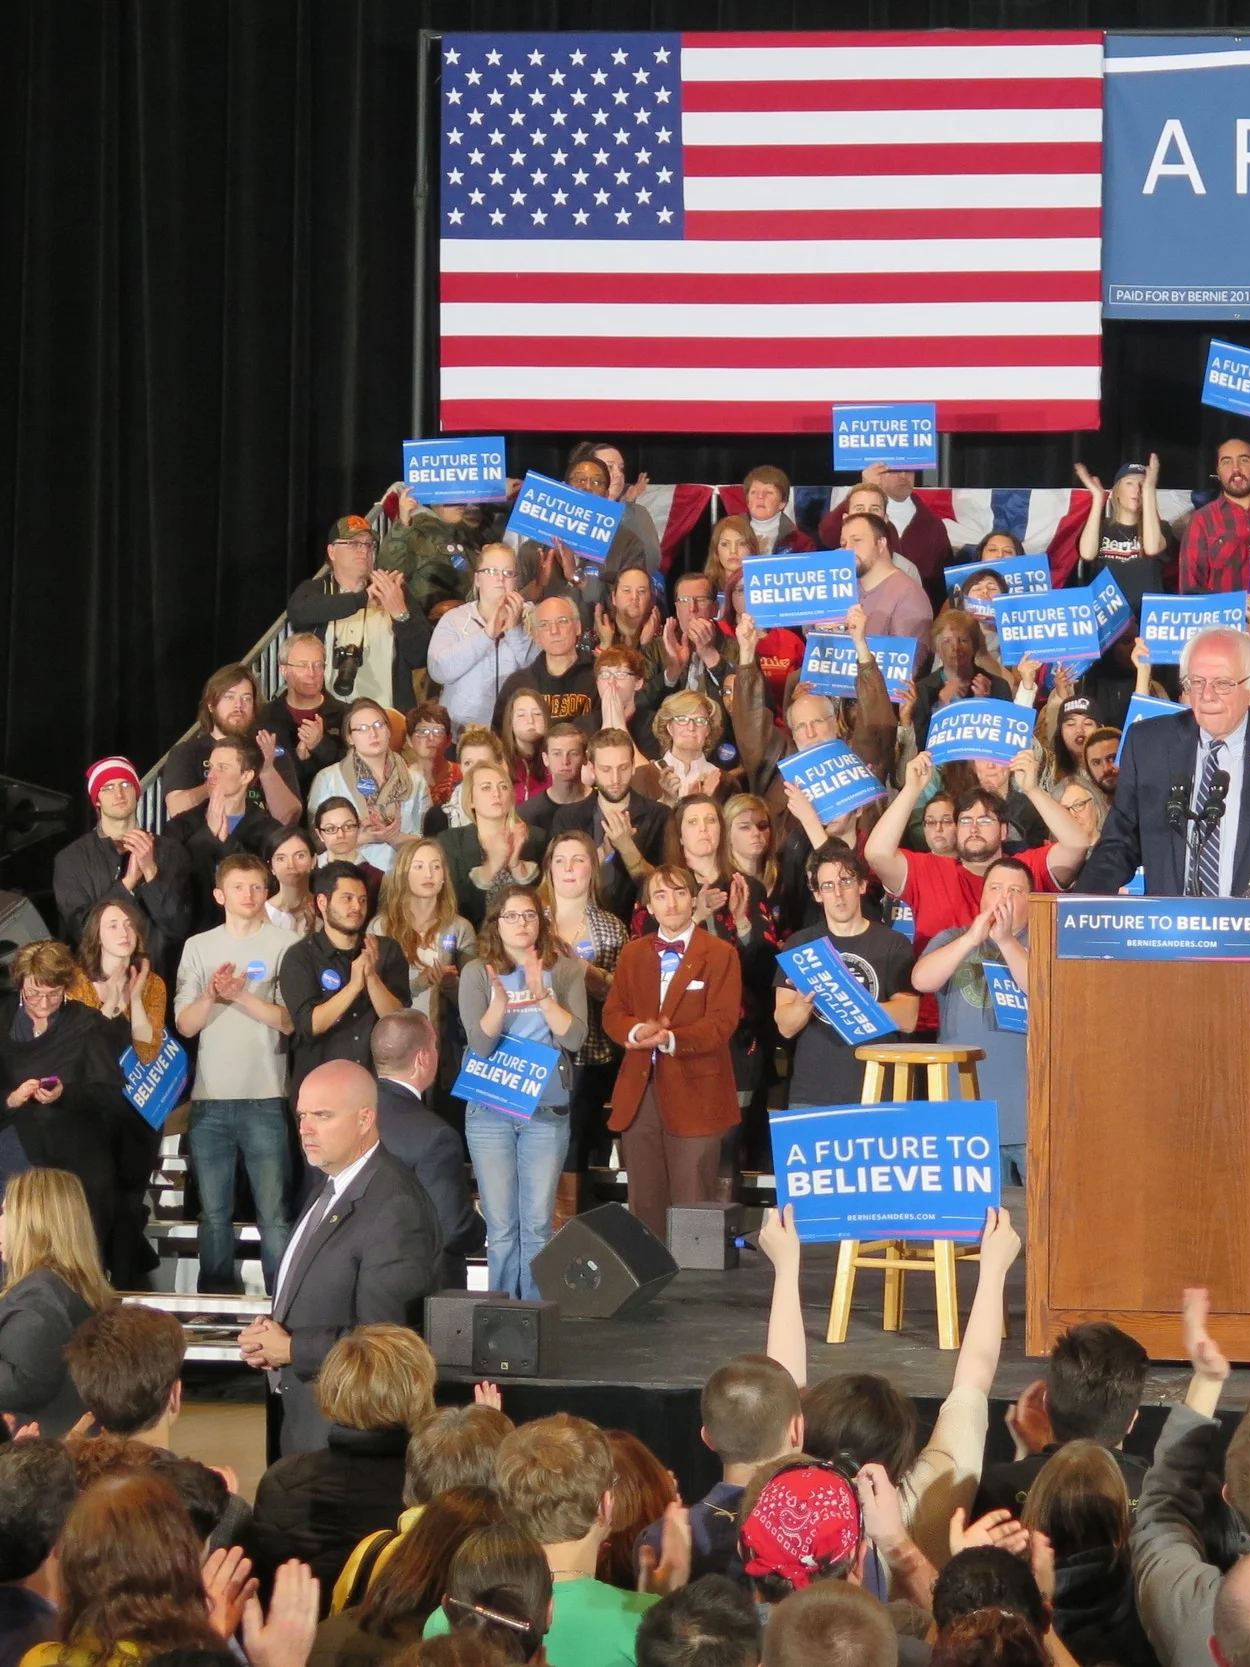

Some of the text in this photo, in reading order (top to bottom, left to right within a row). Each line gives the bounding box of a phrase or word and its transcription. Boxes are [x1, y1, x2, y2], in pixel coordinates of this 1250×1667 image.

[1142, 118, 1206, 195] A
[1116, 289, 1143, 301] PAID
[1145, 290, 1169, 301] FOR
[1171, 290, 1186, 302] BY
[1187, 290, 1228, 302] BERNIE
[1211, 356, 1220, 368] A
[838, 419, 932, 432] A FUTURE TO
[838, 433, 932, 448] BELIEVE IN
[409, 452, 501, 467] A FUTURE TO
[409, 466, 502, 482] BELIEVE IN
[524, 488, 615, 528] A FUTURE TO
[518, 500, 589, 535] BELIEVE
[590, 526, 611, 542] IN
[749, 567, 852, 587] A FUTURE TO
[749, 582, 853, 604] BELIEVE IN
[1001, 604, 1091, 624] A FUTURE TO
[1146, 608, 1242, 624] A FUTURE TO
[1002, 620, 1093, 641] BELIEVE IN
[890, 653, 909, 664] TO
[886, 666, 907, 680] IN
[931, 714, 1029, 734] A FUTURE TO
[928, 726, 1027, 748] BELIEVE IN
[1064, 914, 1076, 928] A
[1078, 914, 1144, 929] FUTURE
[1147, 915, 1172, 930] TO
[1126, 939, 1217, 948] BERNIESANDERS.COM
[792, 952, 812, 970] TO
[802, 948, 878, 1035] BELIEVE IN
[133, 1040, 180, 1108] BELIEVE IN
[465, 1058, 520, 1088] BELIEVE
[520, 1080, 542, 1098] IN
[530, 1062, 547, 1080] TO
[786, 1135, 990, 1166] A FUTURE TO
[786, 1164, 992, 1197] BELIEVE IN
[846, 1213, 936, 1221] BERNIESANDERS.COM
